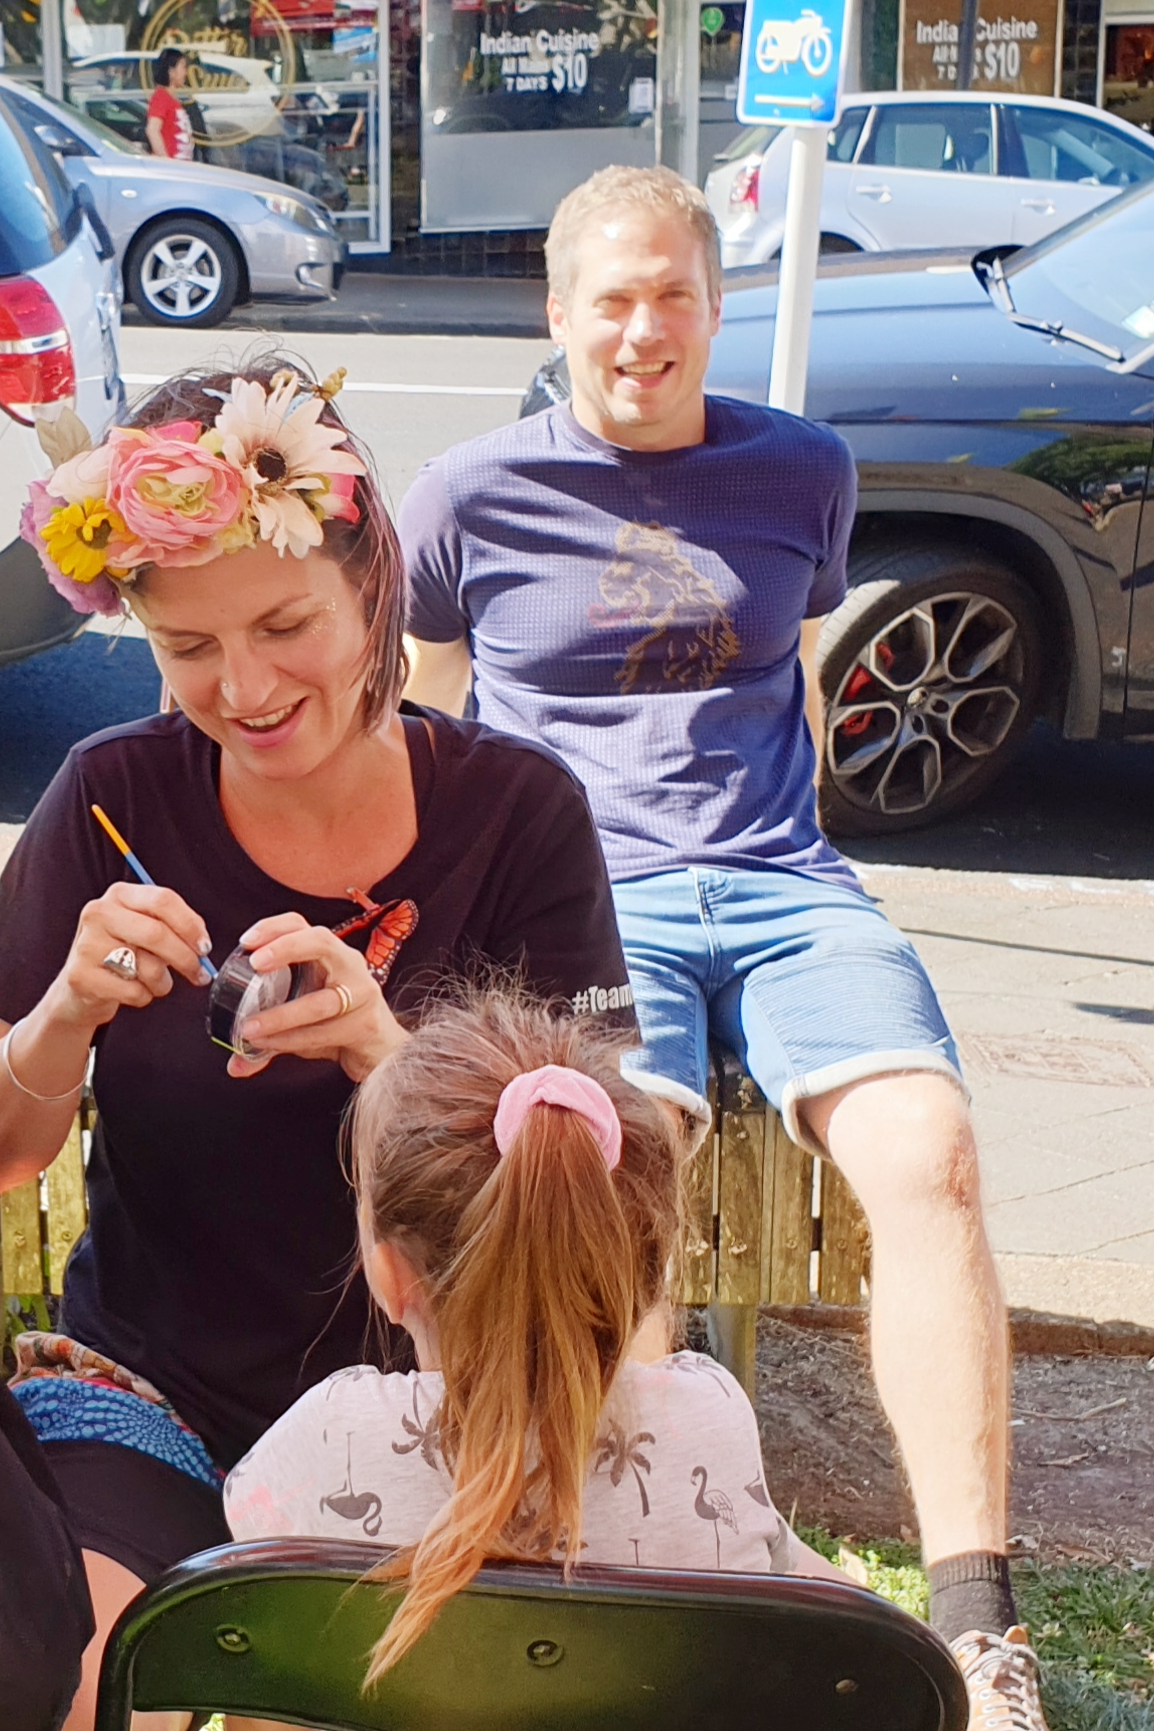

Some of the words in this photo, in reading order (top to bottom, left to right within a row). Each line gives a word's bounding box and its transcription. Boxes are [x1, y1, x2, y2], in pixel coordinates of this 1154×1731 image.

[480, 30, 530, 55] Indian
[536, 28, 599, 51] Cuisine
[917, 19, 960, 44] India
[975, 15, 1038, 42] Cuisine
[551, 52, 588, 93] $10
[984, 41, 1020, 81] $10
[516, 75, 548, 91] DAYS
[571, 984, 634, 1015] #Team
